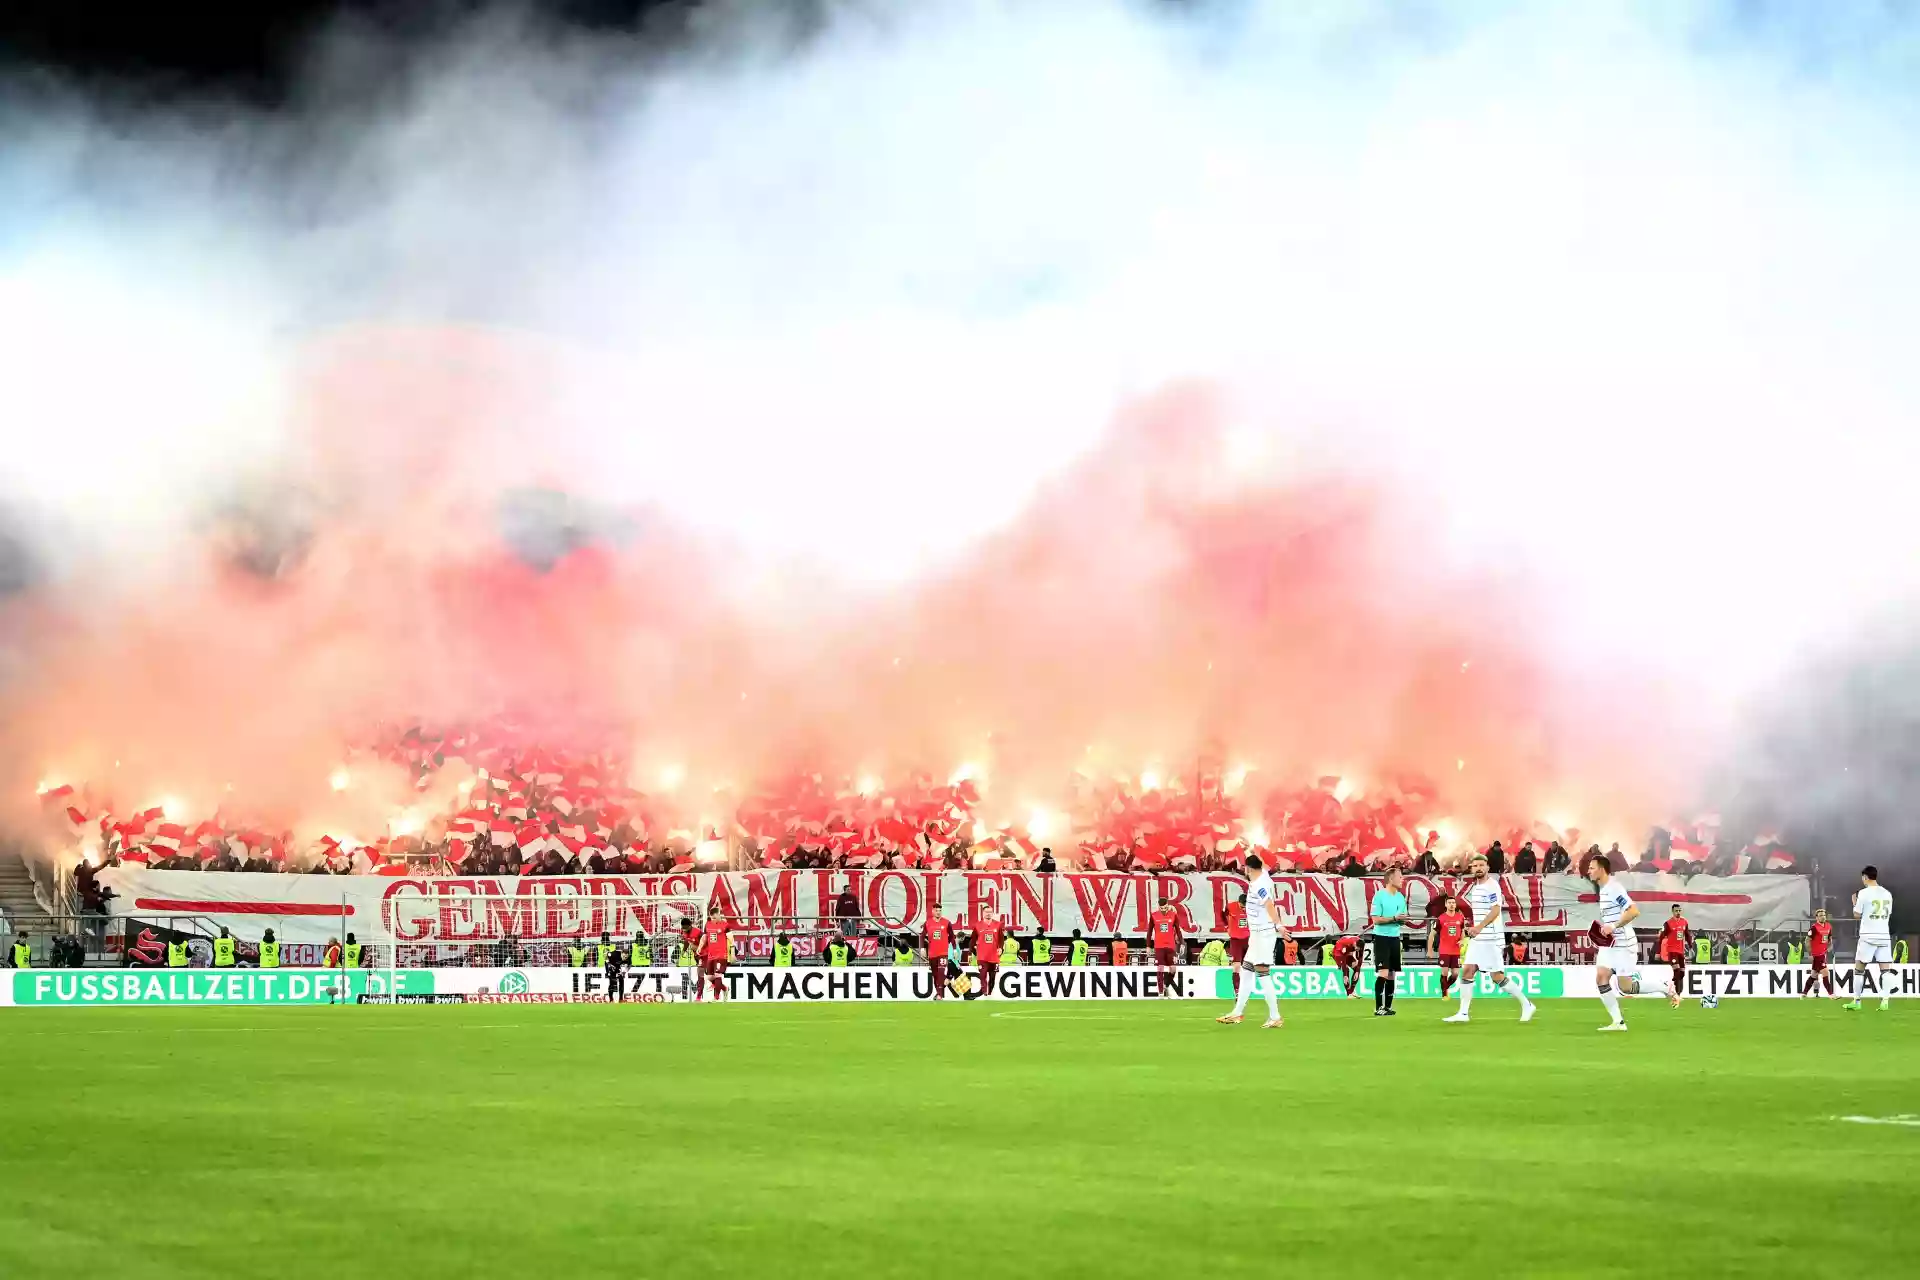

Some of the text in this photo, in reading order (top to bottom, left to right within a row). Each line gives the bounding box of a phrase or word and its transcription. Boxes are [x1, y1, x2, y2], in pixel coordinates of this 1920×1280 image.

[382, 871, 800, 941] GEMEINSAM
[812, 870, 1054, 933] HOLEN
[1063, 872, 1201, 934] WIR
[1761, 948, 1777, 961] C3
[572, 971, 1195, 999] JEZT MTMACHEN UD GEWINNEN:
[1688, 968, 1920, 995] ETZT MIMACH
[398, 995, 426, 1004] bwin
[434, 995, 463, 1004] bwin
[481, 993, 550, 1003] STRAUSS
[572, 993, 611, 1003] ERGO
[623, 993, 665, 1003] ERGO
